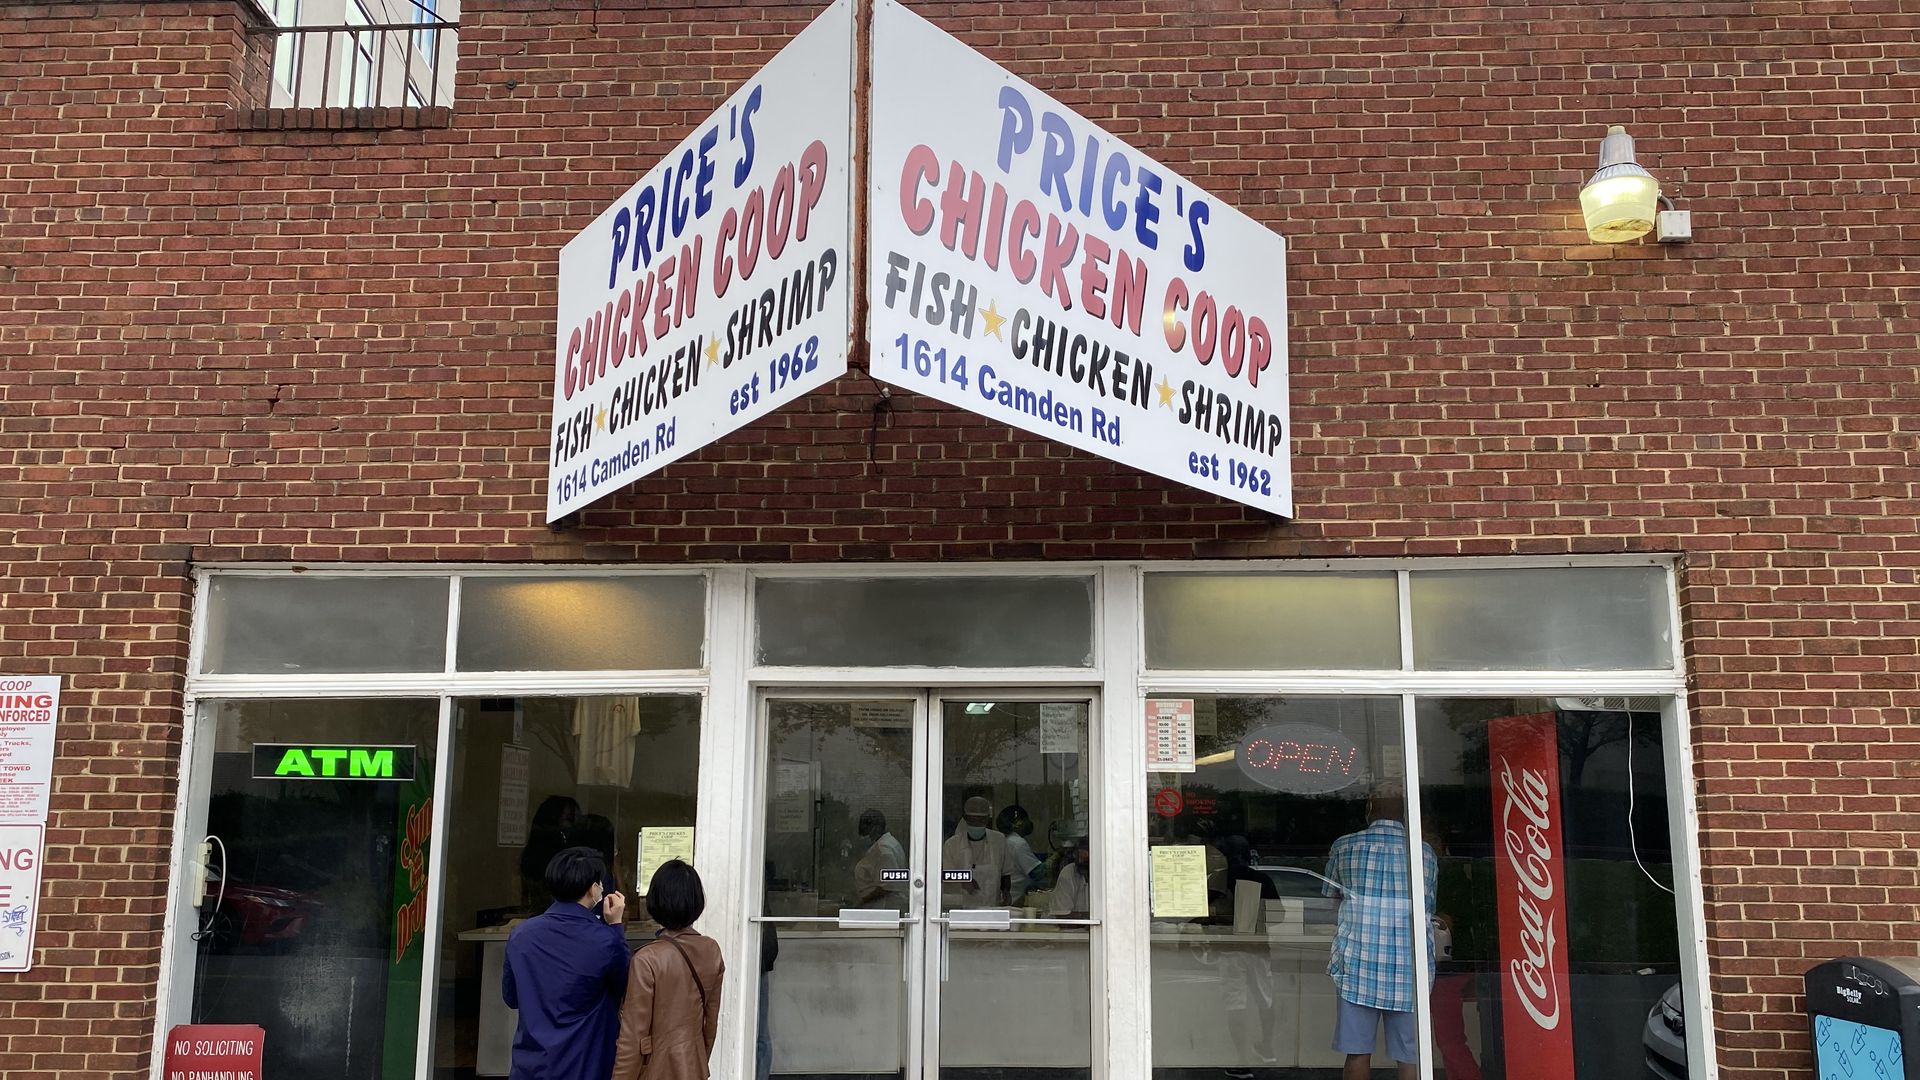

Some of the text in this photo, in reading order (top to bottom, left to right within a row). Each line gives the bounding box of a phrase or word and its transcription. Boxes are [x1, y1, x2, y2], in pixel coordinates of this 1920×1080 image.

[609, 84, 762, 289] PRICE'S
[997, 85, 1210, 272] PRICE'S
[564, 139, 828, 400] CHICKEN COOP
[899, 144, 1272, 388] CHICKEN COOP
[554, 248, 837, 467] FISH CHICKEN SHRIMP
[730, 335, 819, 416] est 1962
[884, 250, 1282, 457] FISH CHICKEN SHRIMP
[895, 332, 1120, 446] 1614 Camden Rd
[556, 416, 676, 504] 1614 Camden Rd
[1188, 450, 1271, 497] est 1962
[0, 681, 32, 691] COOP
[274, 749, 394, 777] ATM
[1247, 739, 1356, 775] OPEN
[945, 872, 969, 880] PUSH
[1500, 754, 1560, 1030] Coca-Cola
[1836, 985, 1862, 1000] BigBelly
[171, 1071, 185, 1080] NO
[174, 1040, 254, 1056] NO SOLICITING
